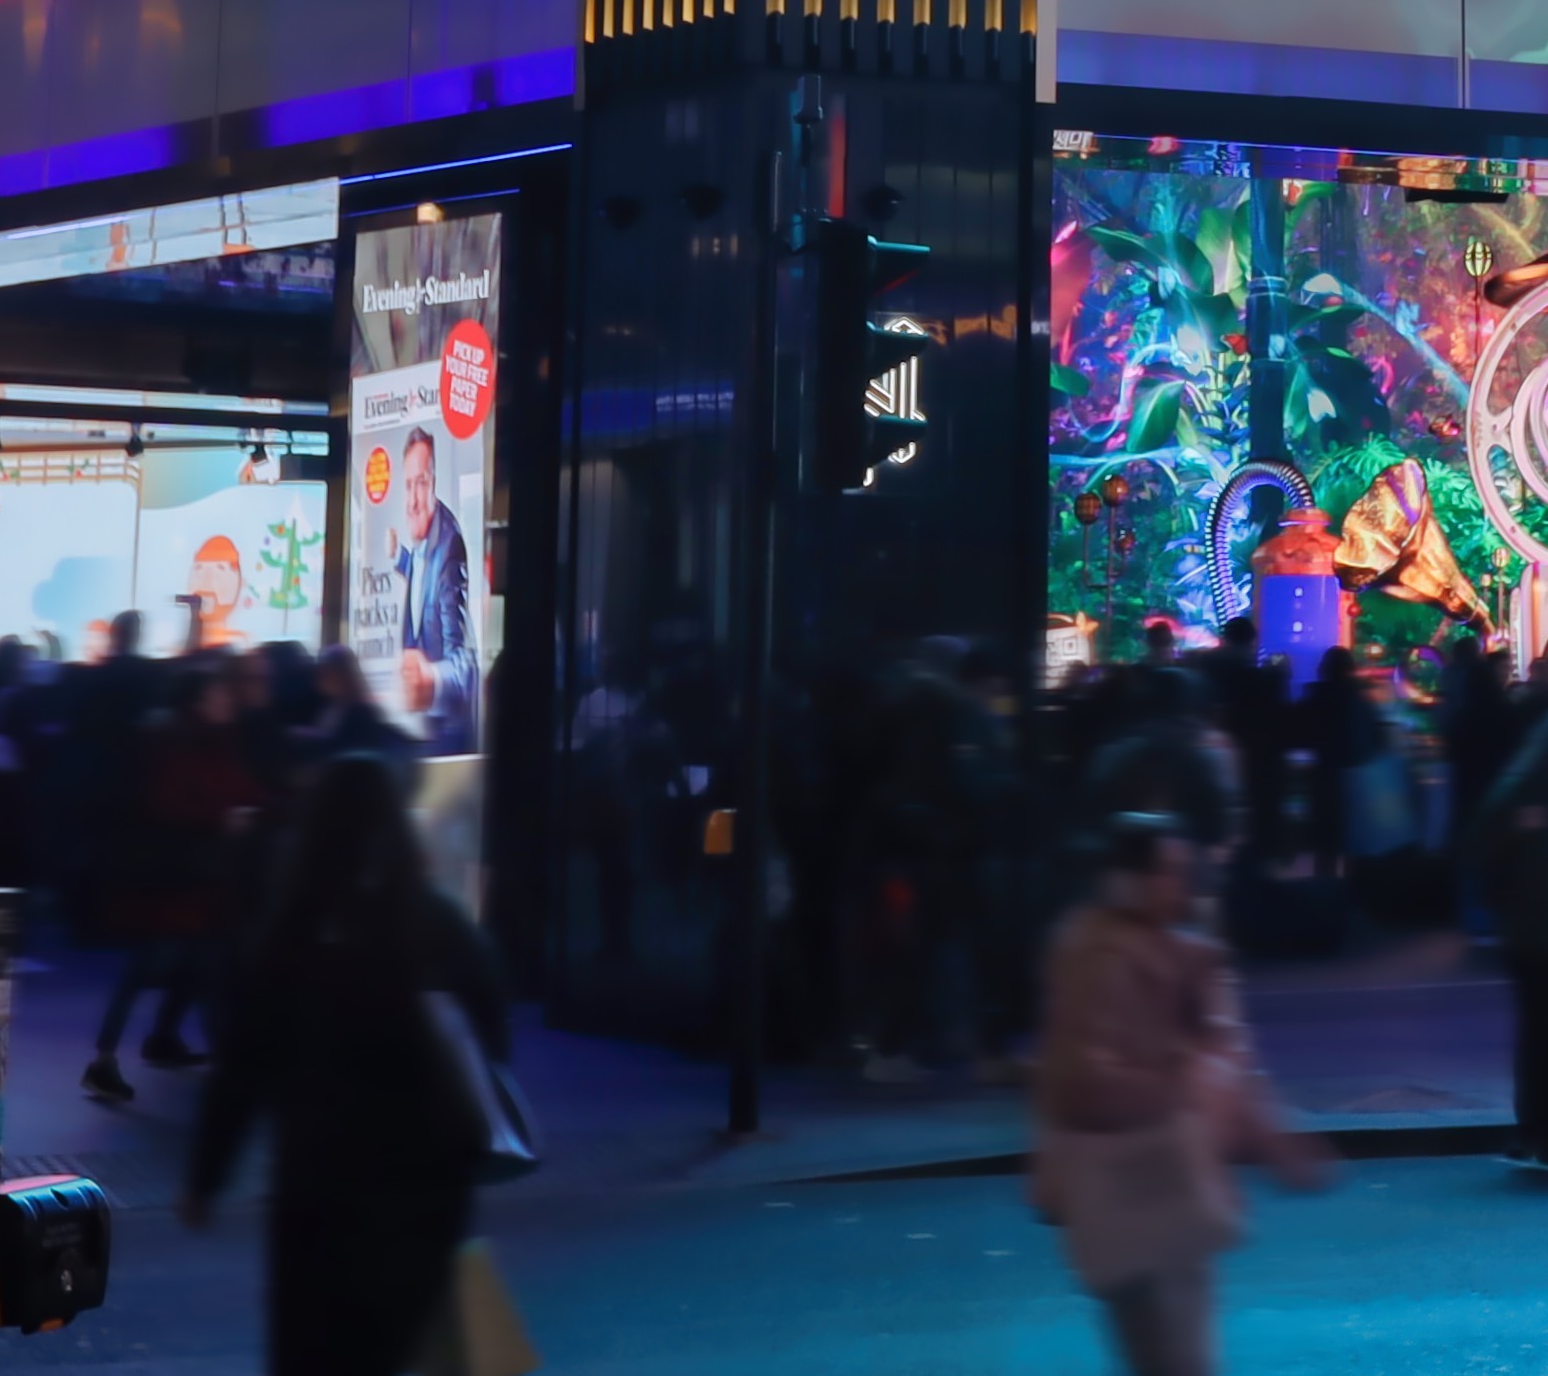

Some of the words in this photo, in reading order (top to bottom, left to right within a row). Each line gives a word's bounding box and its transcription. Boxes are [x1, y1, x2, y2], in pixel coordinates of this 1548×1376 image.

[362, 281, 415, 316] Evening
[424, 269, 490, 306] Standard
[364, 392, 408, 420] Evening
